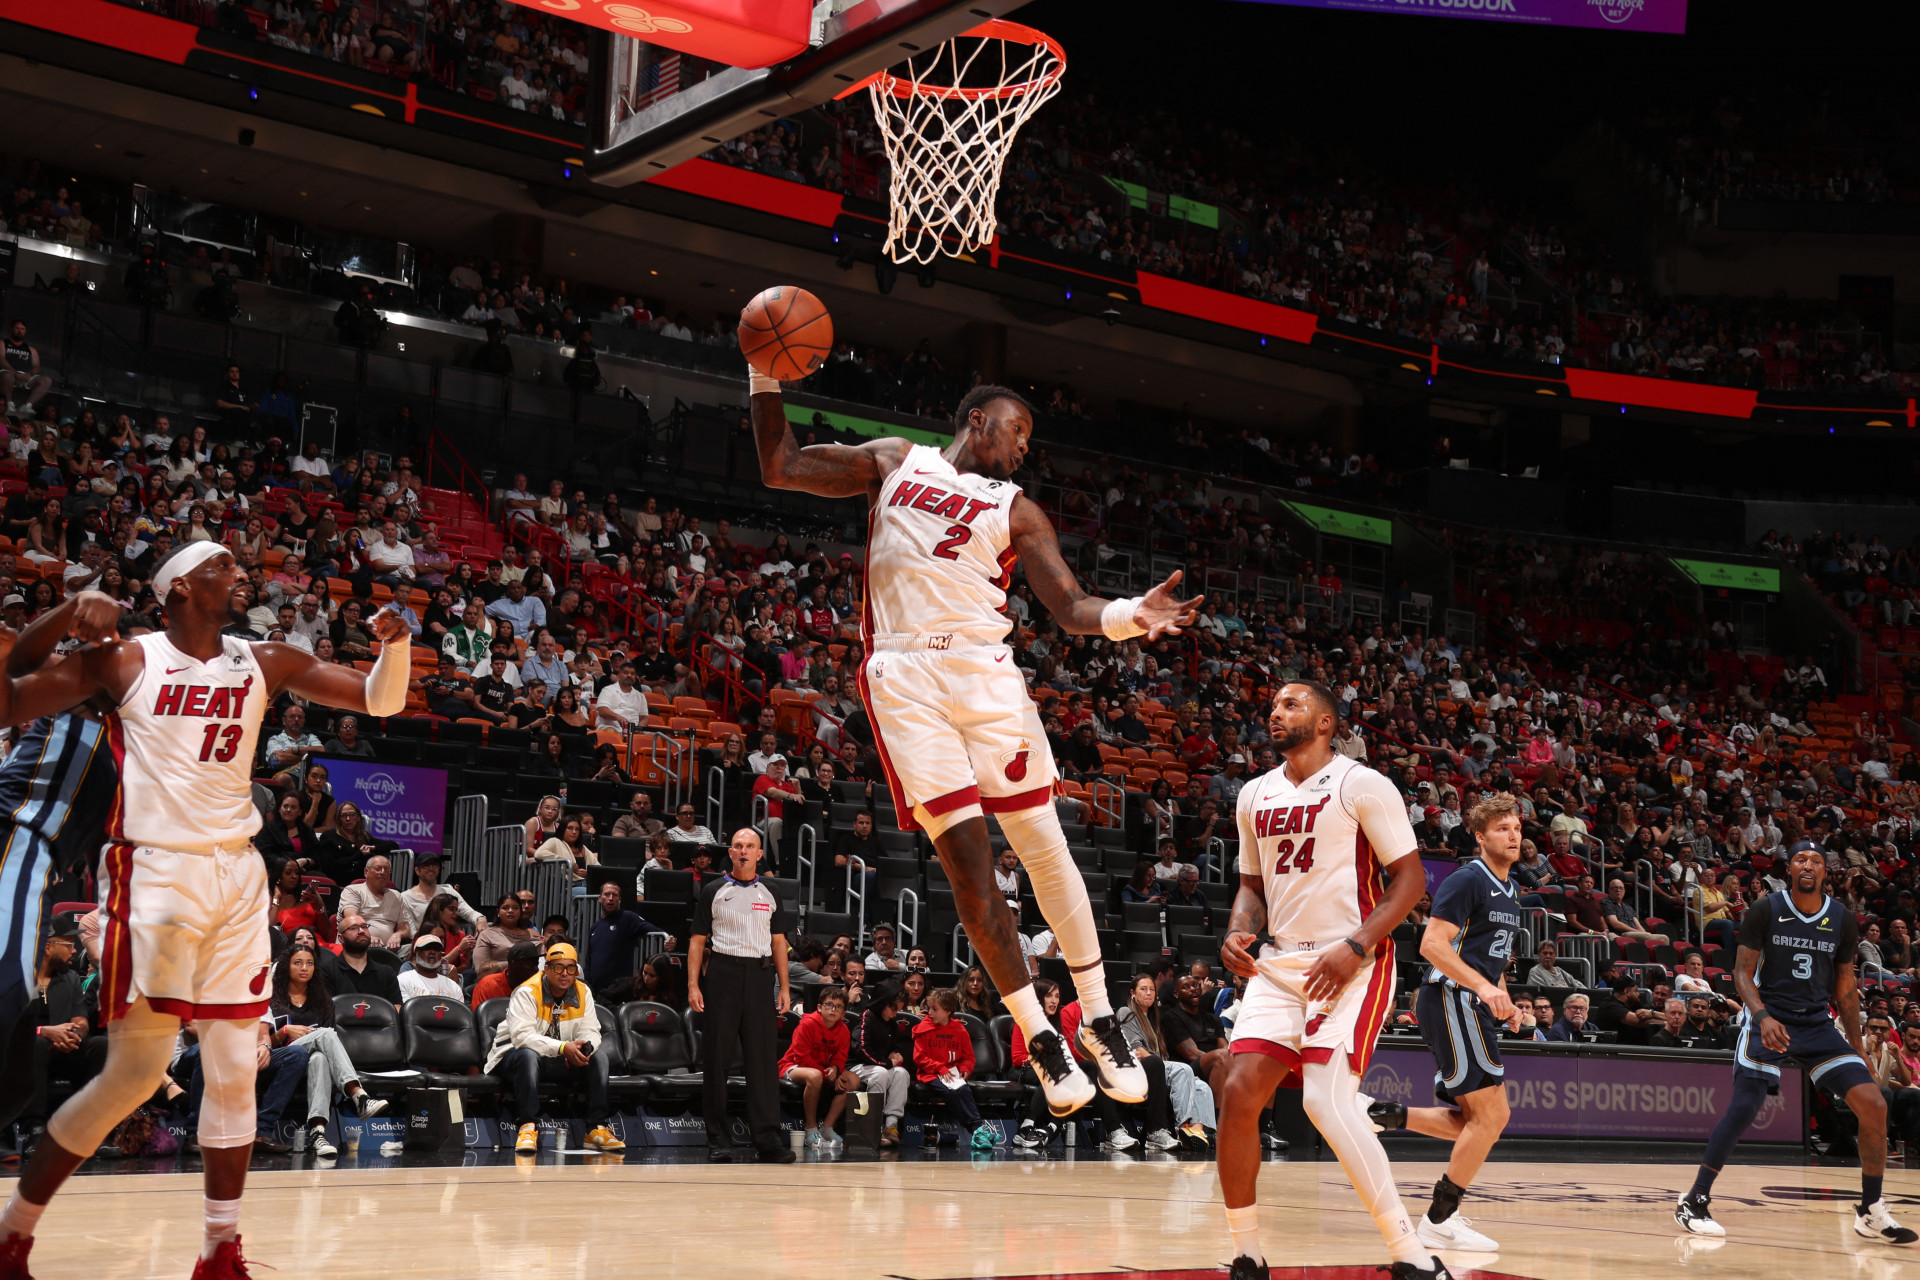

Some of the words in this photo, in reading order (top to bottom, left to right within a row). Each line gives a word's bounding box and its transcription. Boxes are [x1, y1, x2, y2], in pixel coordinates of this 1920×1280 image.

[7, 348, 29, 356] MIAMI
[888, 480, 999, 524] HEAT
[932, 524, 972, 561] 2
[153, 674, 253, 718] HEAT
[487, 689, 505, 699] HEAT
[199, 723, 244, 762] 13
[354, 777, 381, 790] Hard
[380, 779, 405, 795] Rock
[368, 818, 434, 837] TSBOOK
[400, 812, 425, 820] LEGAL
[1255, 794, 1331, 838] HEAT
[1275, 837, 1316, 875] 24
[1772, 934, 1836, 953] GRIZZLIES
[1792, 953, 1813, 979] 3
[1382, 1076, 1413, 1099] Rock
[1564, 1081, 1716, 1114] SPORTSBOOK
[411, 1114, 429, 1122] Kaseya
[645, 1121, 662, 1130] ONE
